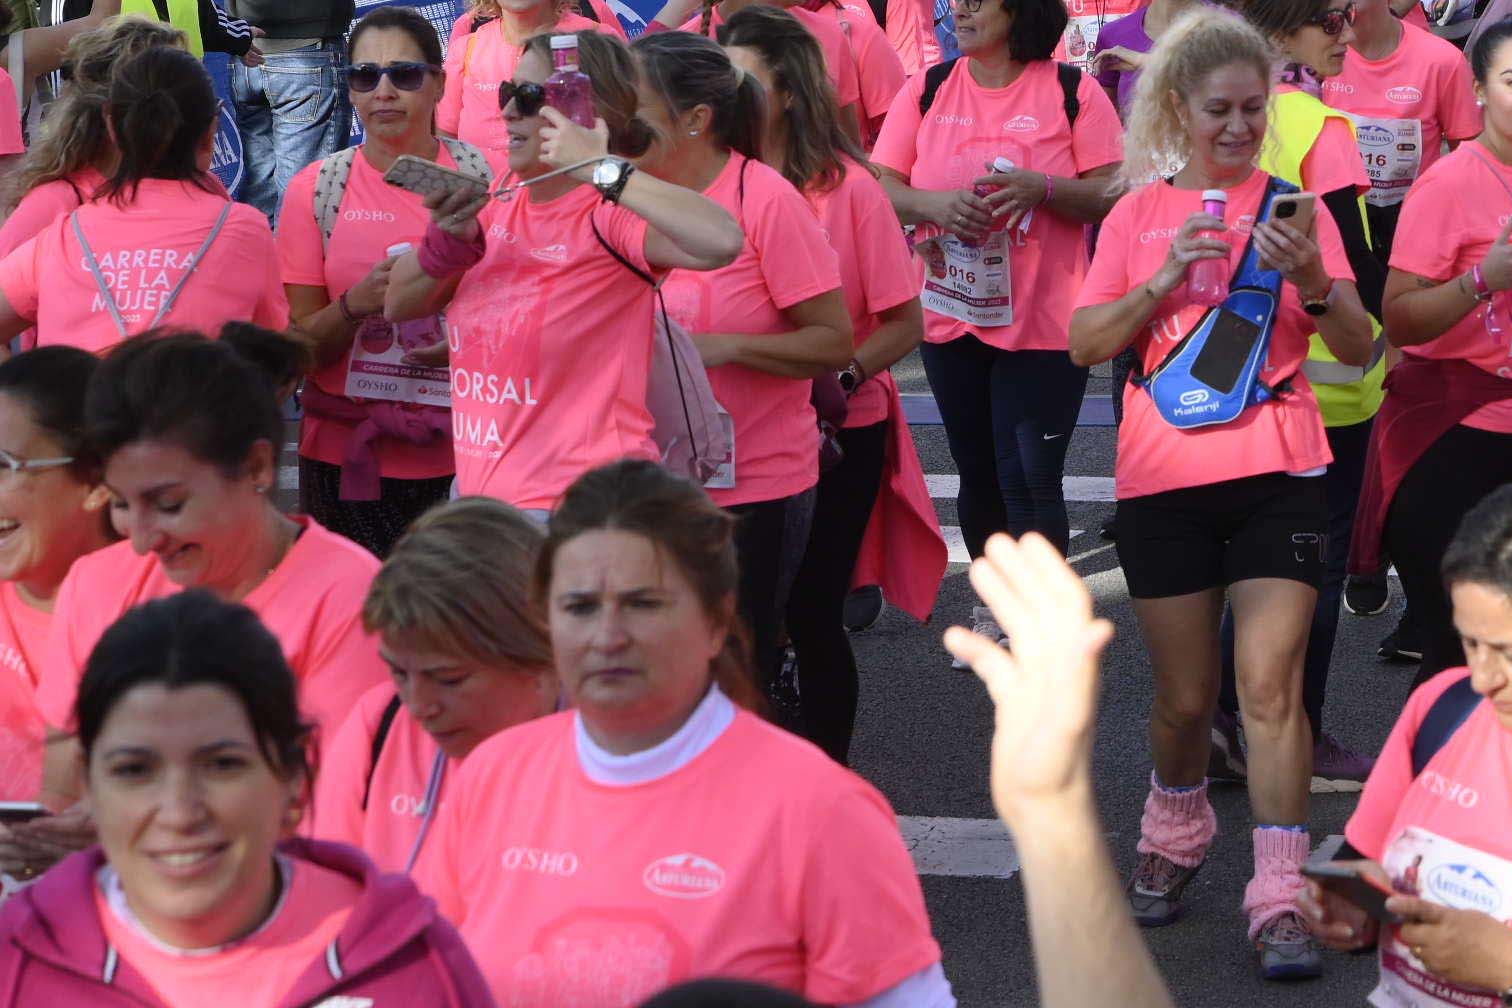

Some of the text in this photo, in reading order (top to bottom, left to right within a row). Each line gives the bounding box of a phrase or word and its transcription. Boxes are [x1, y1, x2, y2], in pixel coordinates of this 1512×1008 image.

[343, 208, 395, 223] OYSHO
[80, 248, 199, 273] CARRERA
[101, 270, 171, 289] DE LA
[948, 265, 976, 285] 016
[91, 289, 173, 313] MUJER
[363, 363, 451, 380] CARRERA DE LA MUJER
[357, 379, 399, 393] OYSHO
[450, 368, 539, 406] ORSAL
[1173, 400, 1220, 418] Kalenji
[1451, 988, 1493, 1007] MUJER
